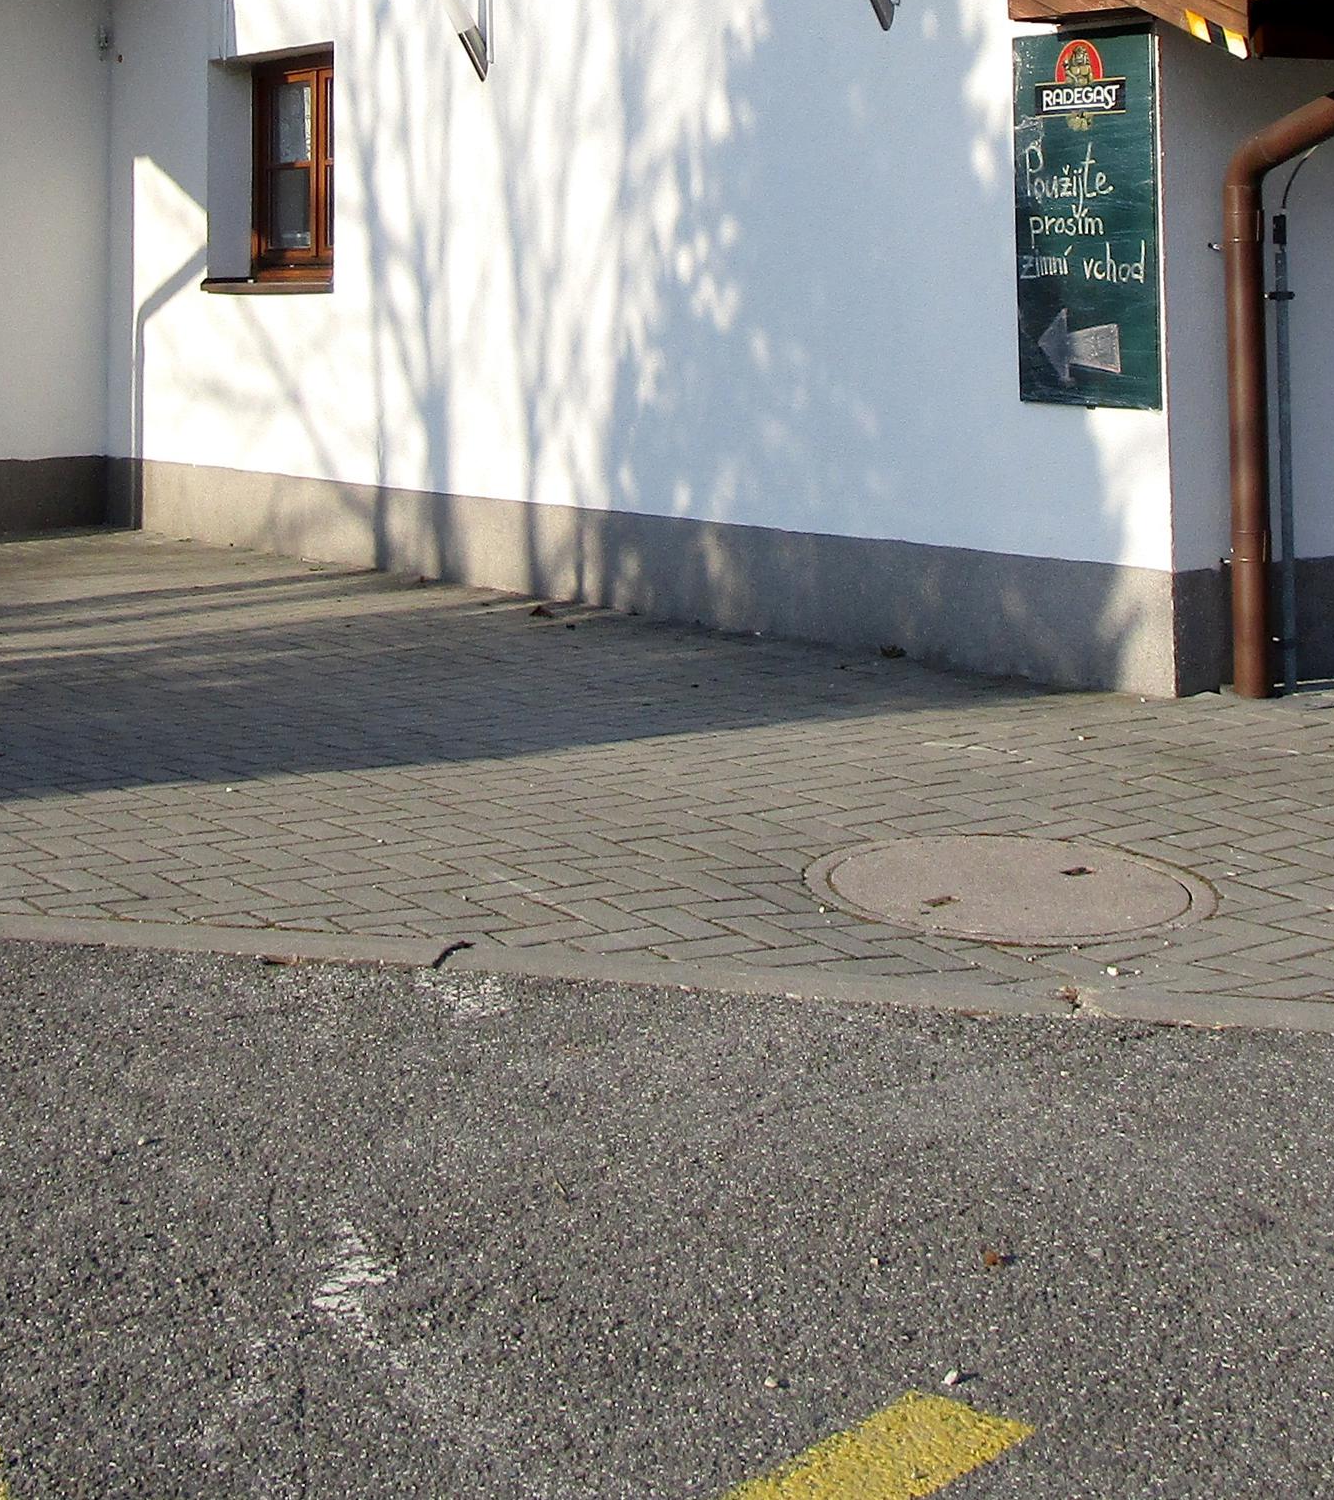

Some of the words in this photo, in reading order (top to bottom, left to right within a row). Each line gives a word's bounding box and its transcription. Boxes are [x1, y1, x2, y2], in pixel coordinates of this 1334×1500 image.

[1042, 85, 1120, 110] RADEGAST
[1025, 141, 1114, 216] Použijte
[1029, 208, 1104, 249] prosím
[1020, 245, 1072, 279] zimní
[1083, 240, 1145, 284] vchod
